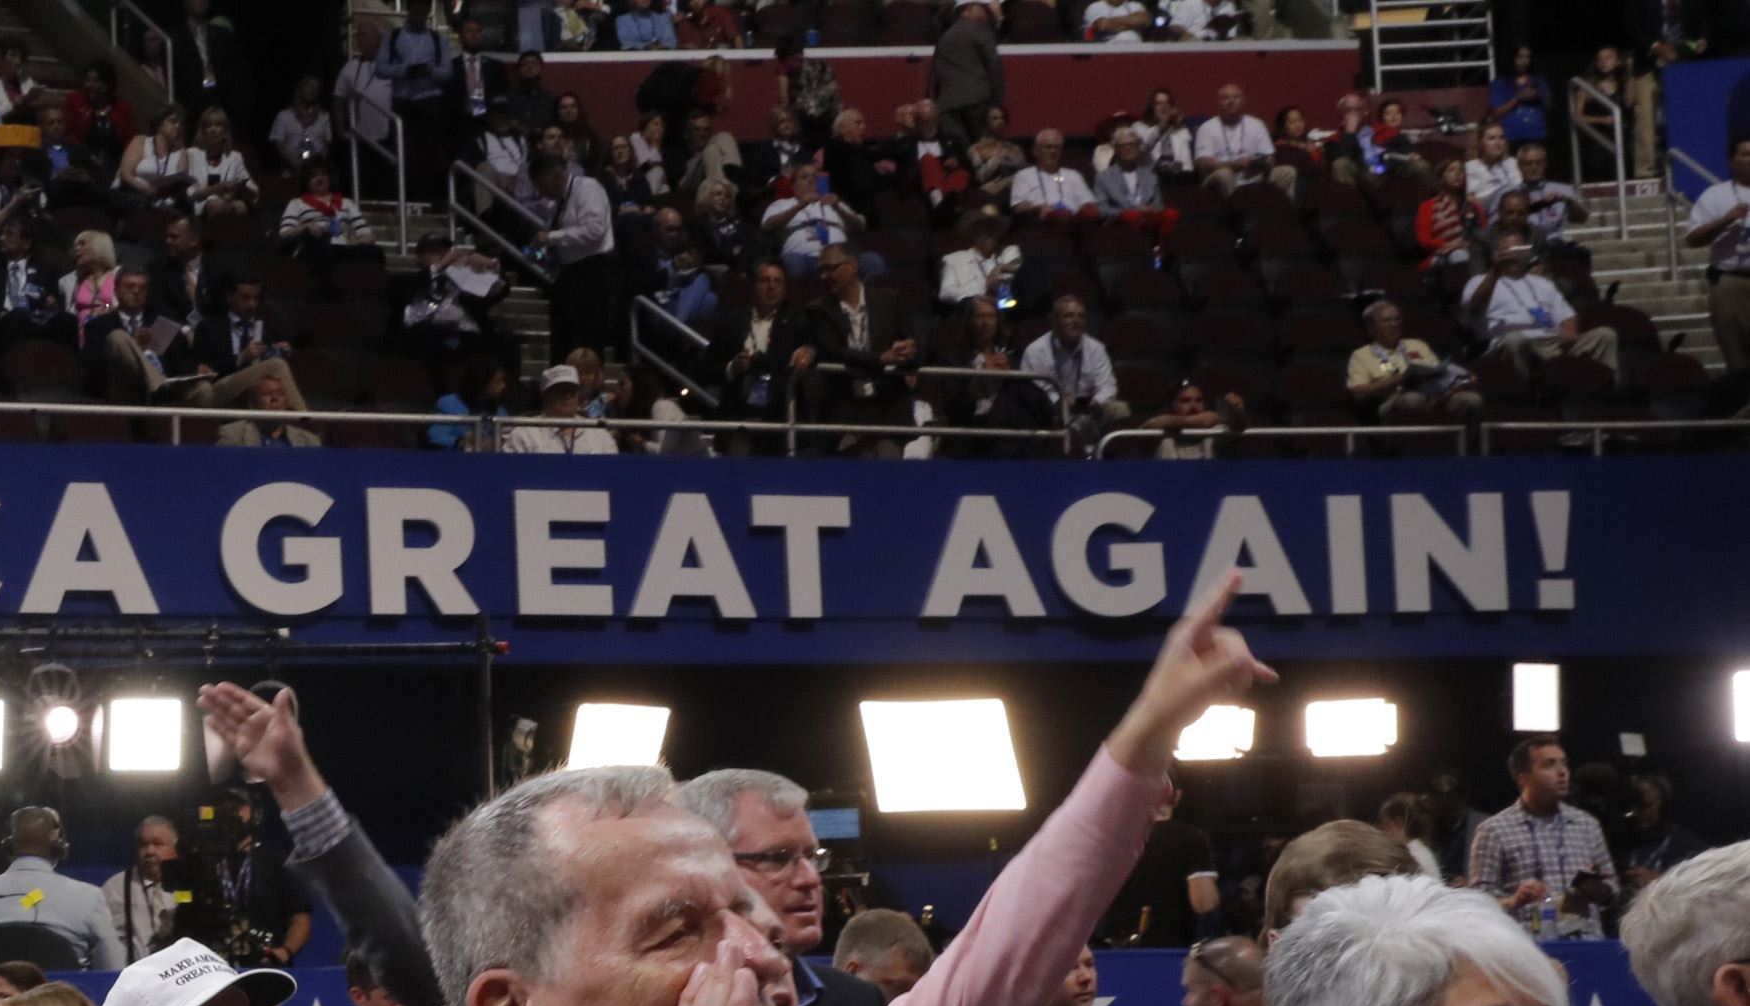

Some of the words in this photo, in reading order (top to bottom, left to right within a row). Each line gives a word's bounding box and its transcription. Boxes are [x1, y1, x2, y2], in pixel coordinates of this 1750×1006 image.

[220, 479, 851, 618] GREAT
[923, 491, 1574, 618] AGAIN!
[158, 958, 195, 981] MAKE
[175, 965, 212, 986] GREAT
